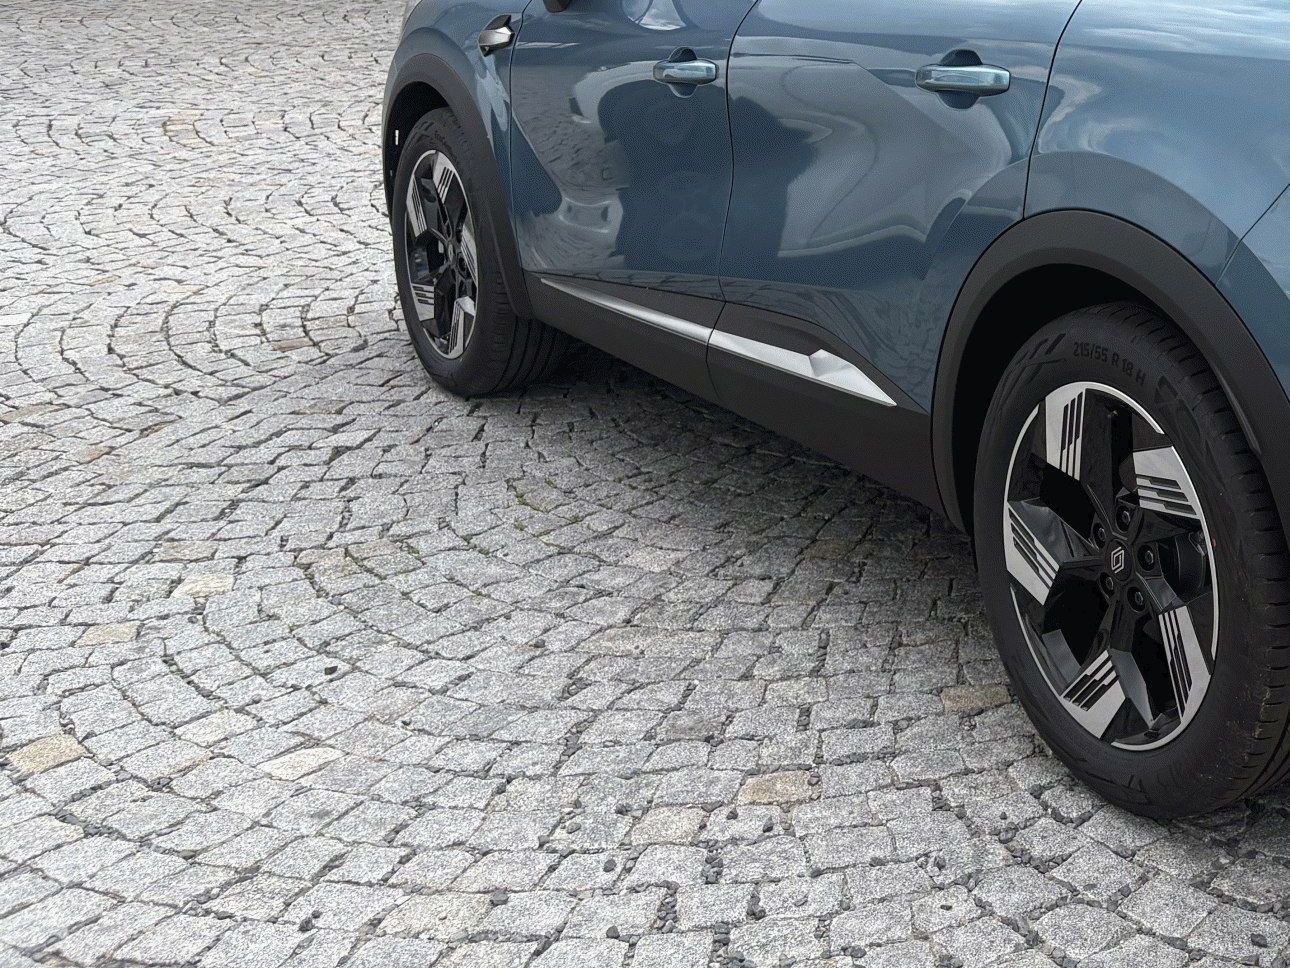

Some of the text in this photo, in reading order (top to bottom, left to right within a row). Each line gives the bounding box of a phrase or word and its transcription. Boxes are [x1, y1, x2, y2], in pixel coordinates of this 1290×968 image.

[1073, 341, 1108, 363] 215/55
[1111, 351, 1120, 368] R
[1122, 358, 1133, 377] 18
